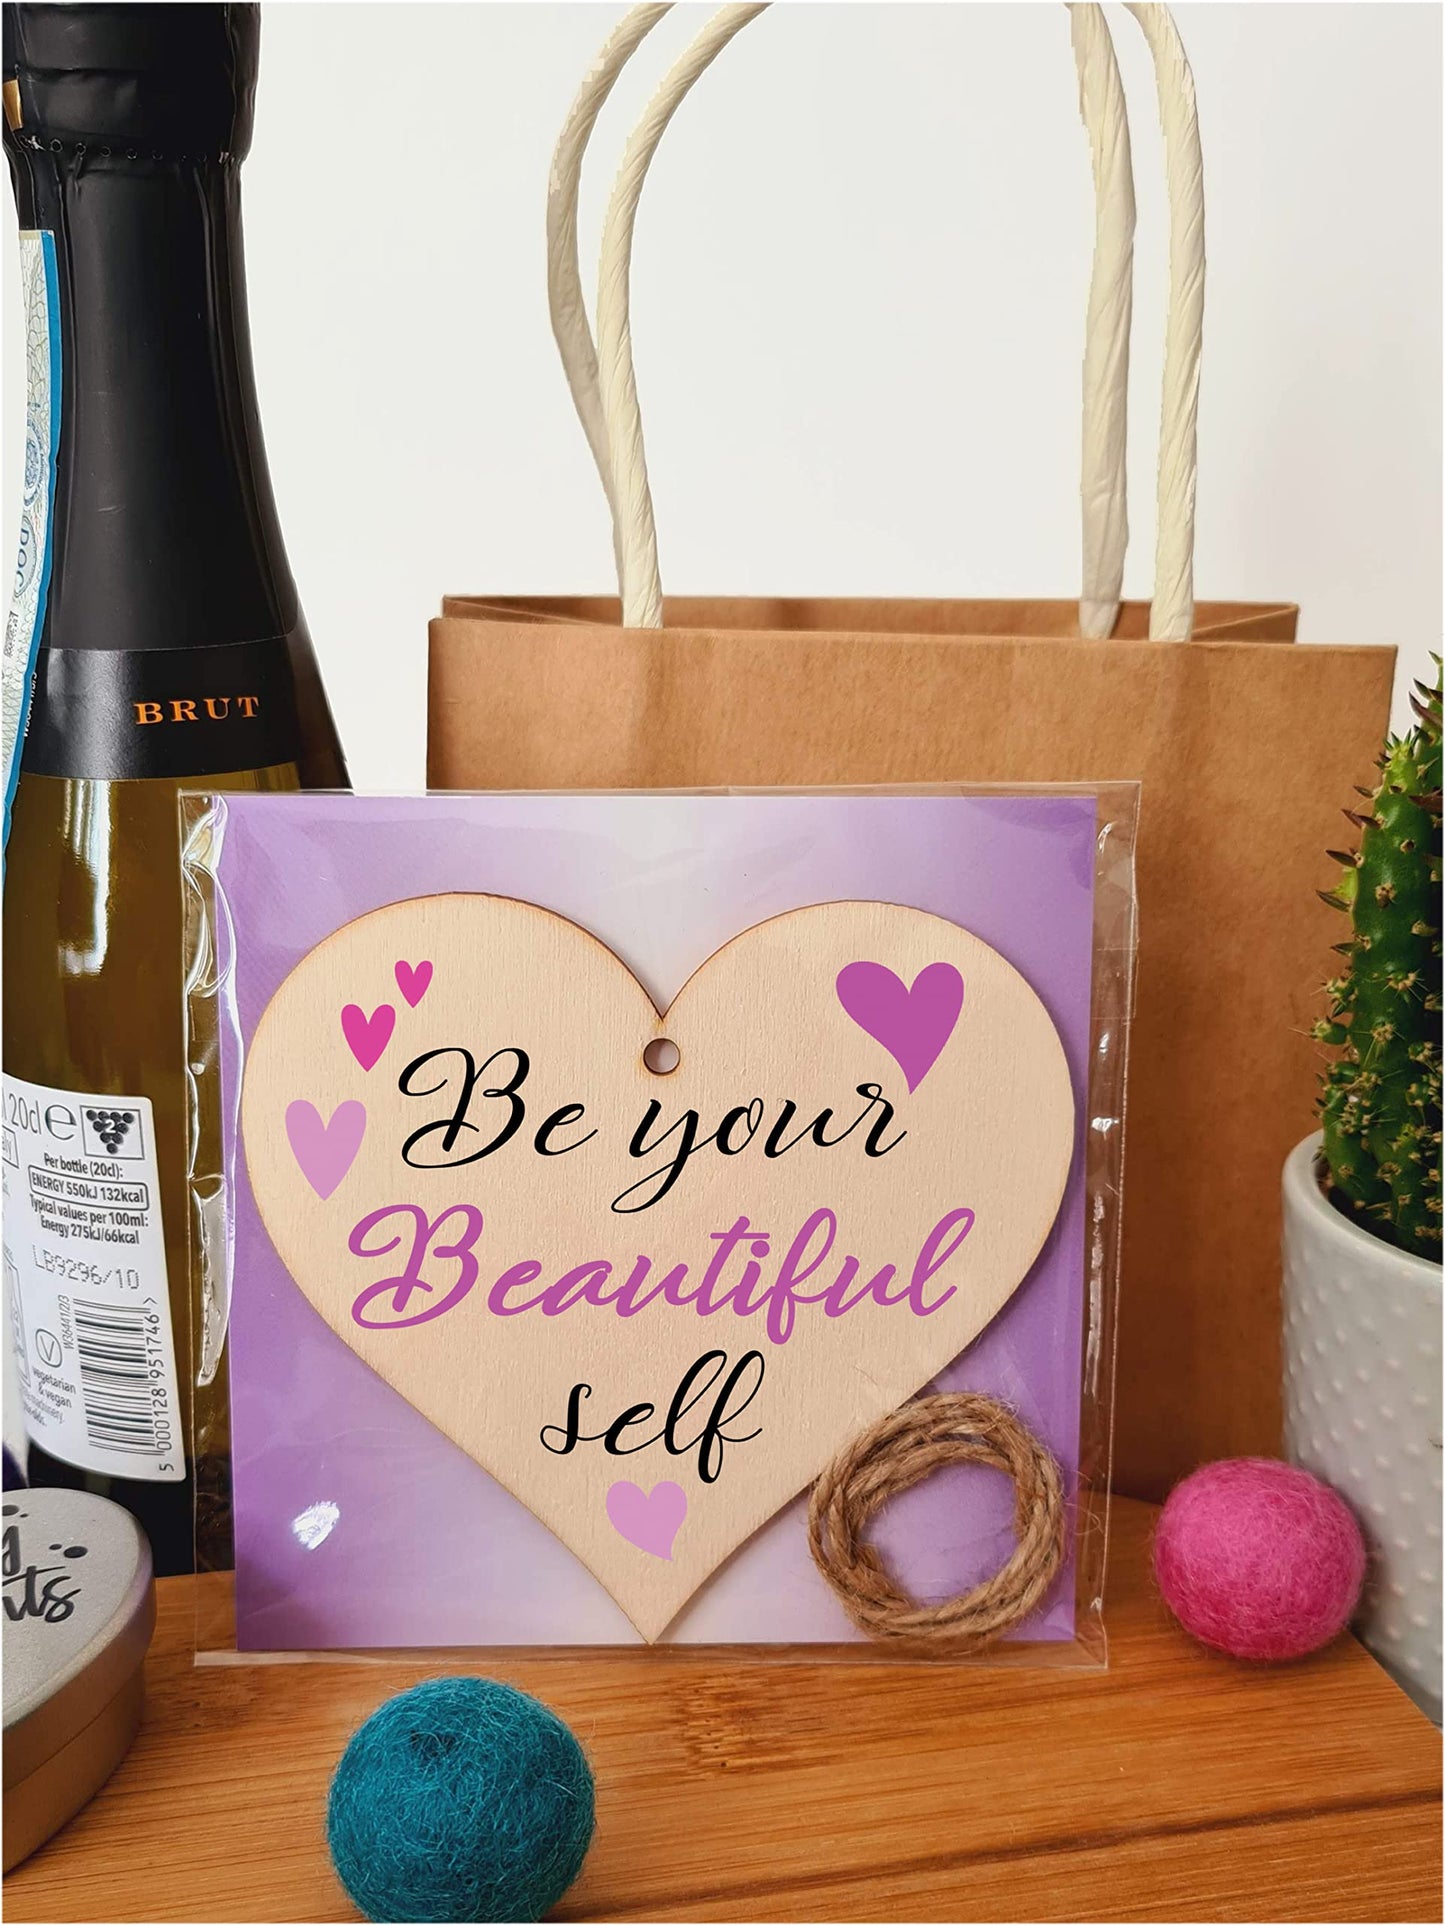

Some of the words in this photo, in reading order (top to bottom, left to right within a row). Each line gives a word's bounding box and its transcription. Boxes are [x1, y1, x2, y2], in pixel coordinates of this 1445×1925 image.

[133, 696, 260, 725] BRUT
[9, 1093, 41, 1135] 20cl
[44, 1104, 77, 1140] e
[398, 1047, 598, 1169] Be
[611, 1082, 908, 1214] your
[44, 1153, 58, 1169] Per
[60, 1155, 88, 1174] bottle
[90, 1161, 123, 1180] (20cl):
[31, 1172, 64, 1193] ENERGY
[66, 1182, 97, 1199] 550kJ
[100, 1187, 144, 1203] 132kcal
[30, 1194, 56, 1215] Typical
[57, 1204, 88, 1221] values
[89, 1212, 107, 1227] per
[108, 1212, 149, 1227] 100ml:
[41, 1215, 69, 1239] Energy
[71, 1223, 140, 1245] 275kJ/66kcal
[347, 1204, 975, 1345] Beautiful
[144, 1314, 165, 1378] 951746
[33, 1366, 76, 1394] vegetarian
[151, 1387, 172, 1451] 000128
[540, 1350, 765, 1485] self
